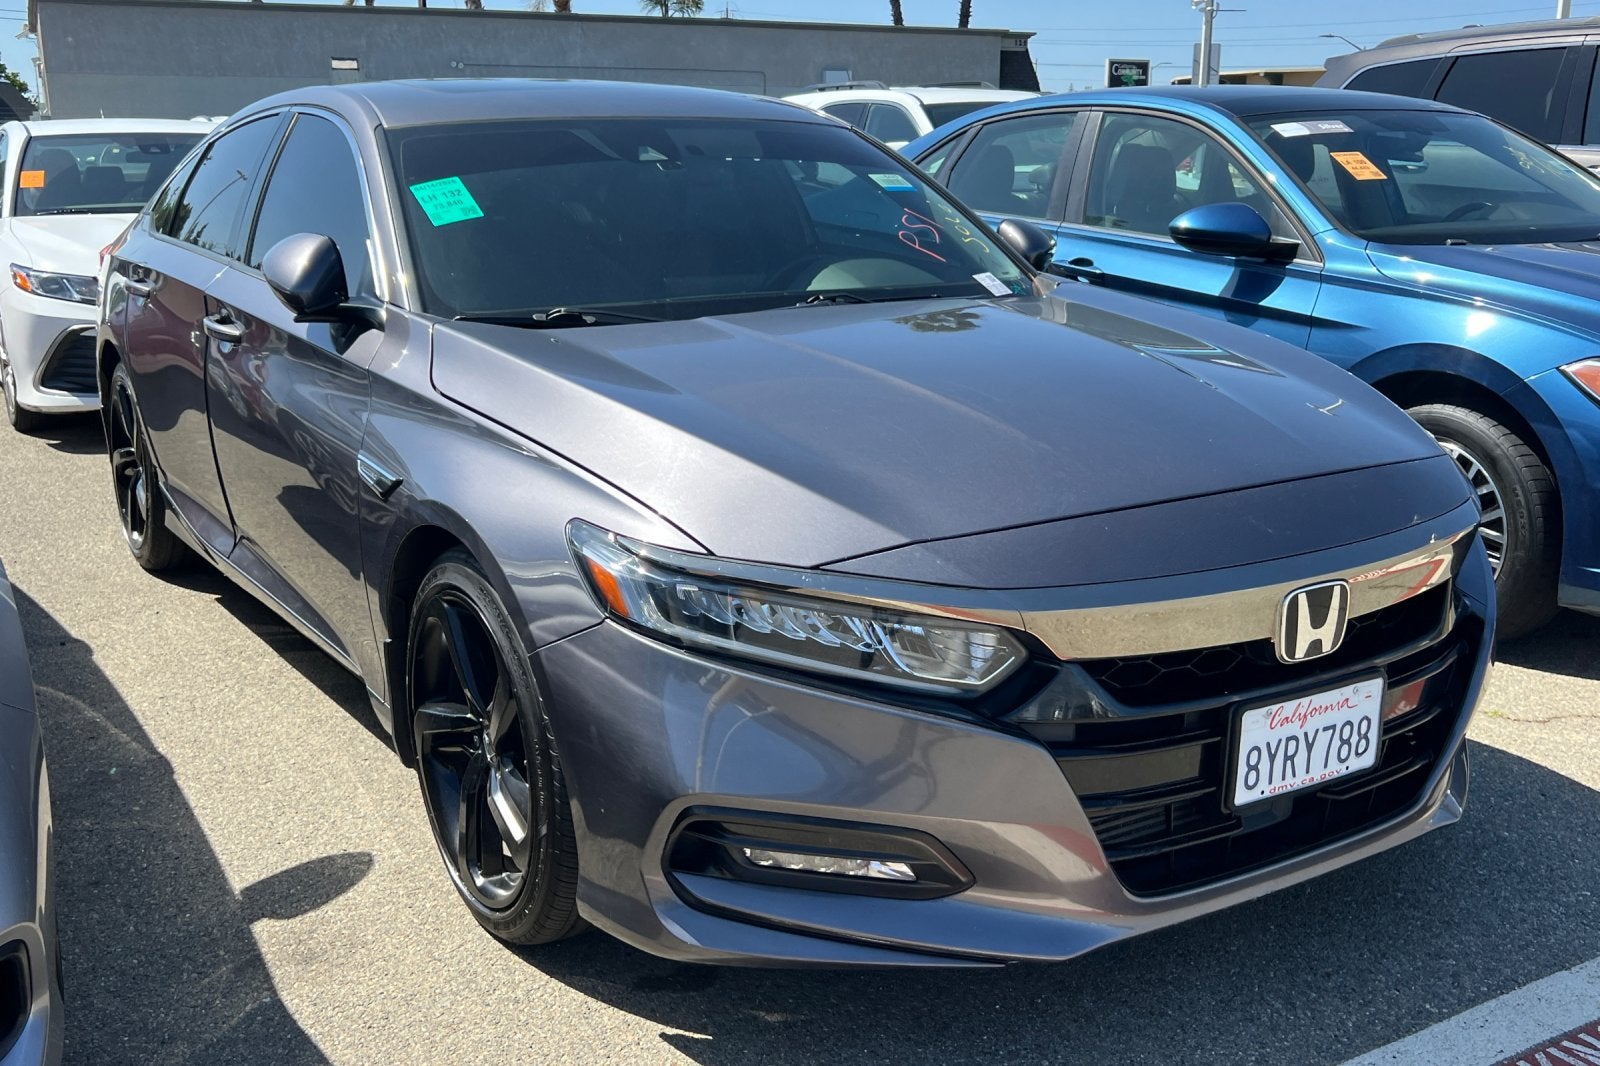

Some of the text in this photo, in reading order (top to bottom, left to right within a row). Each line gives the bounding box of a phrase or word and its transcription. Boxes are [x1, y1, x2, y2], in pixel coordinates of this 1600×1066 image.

[1268, 695, 1358, 731] California
[1243, 715, 1372, 791] 8YRY788
[1268, 767, 1343, 795] dmv.ca.gov
